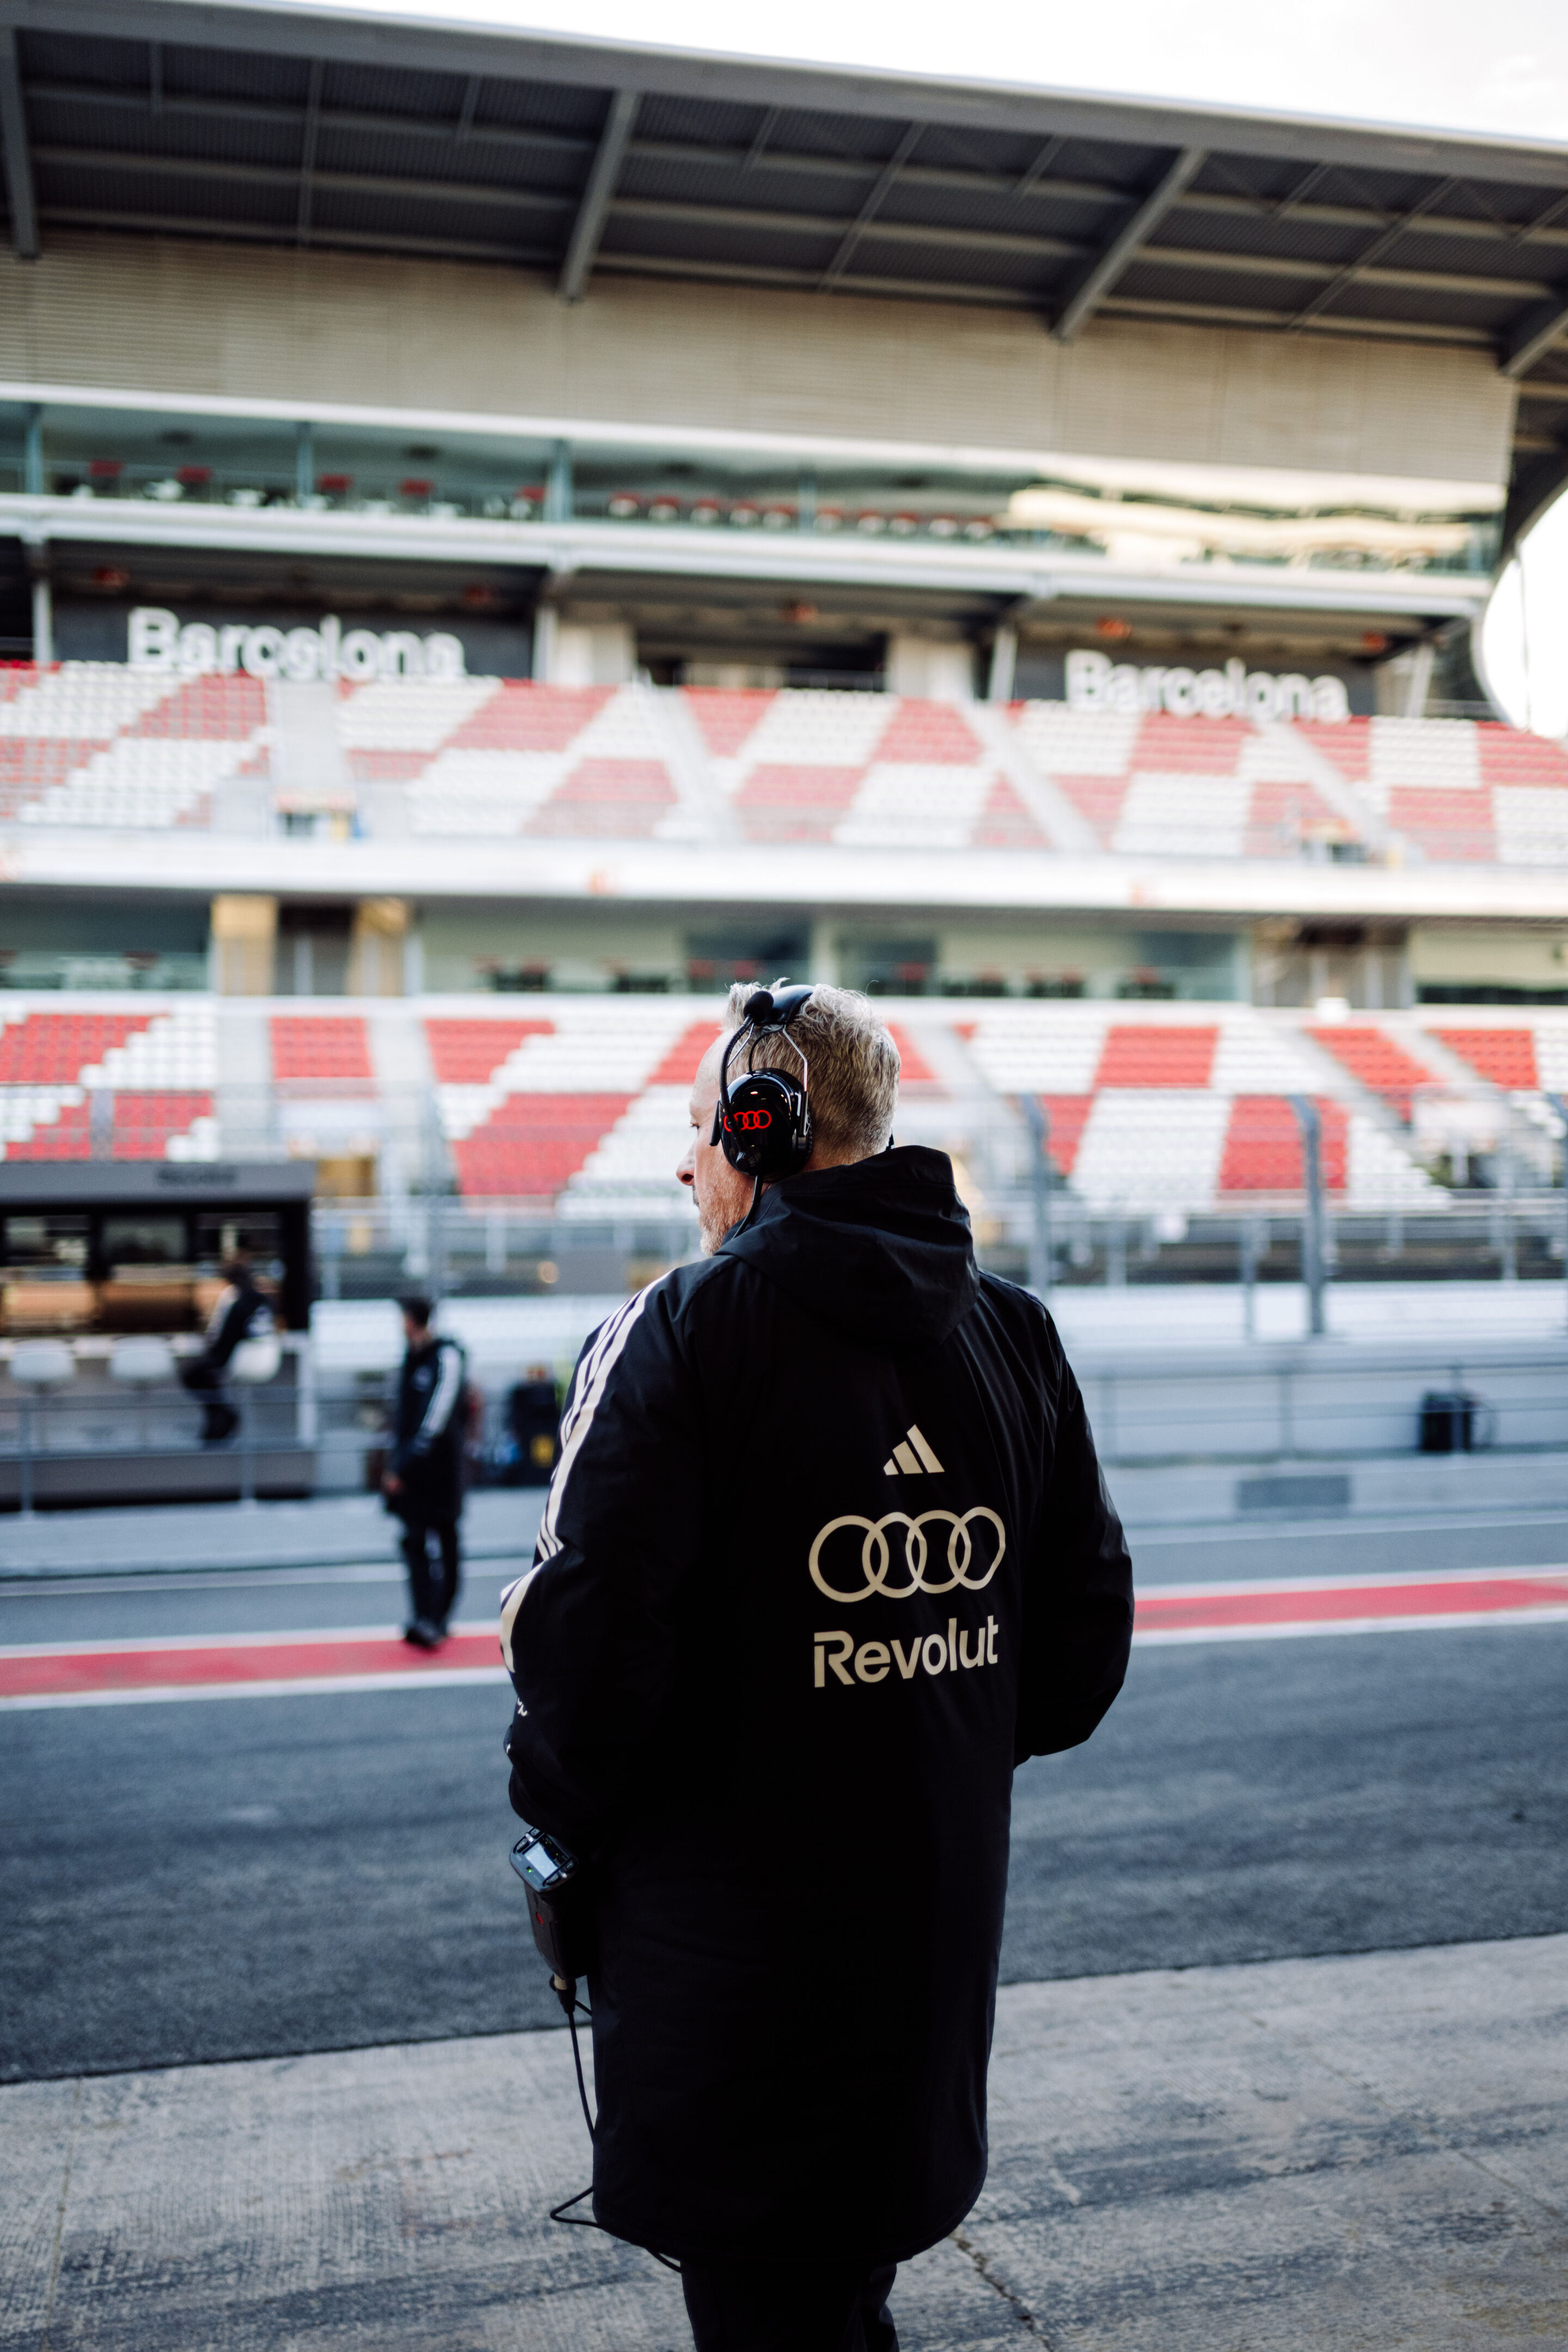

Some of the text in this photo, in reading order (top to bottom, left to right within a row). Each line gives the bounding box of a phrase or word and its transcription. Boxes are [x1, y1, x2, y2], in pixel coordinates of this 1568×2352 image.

[127, 606, 467, 681] Barcelona
[1065, 649, 1351, 724] Barcelona
[814, 1615, 999, 1688] Revolut
